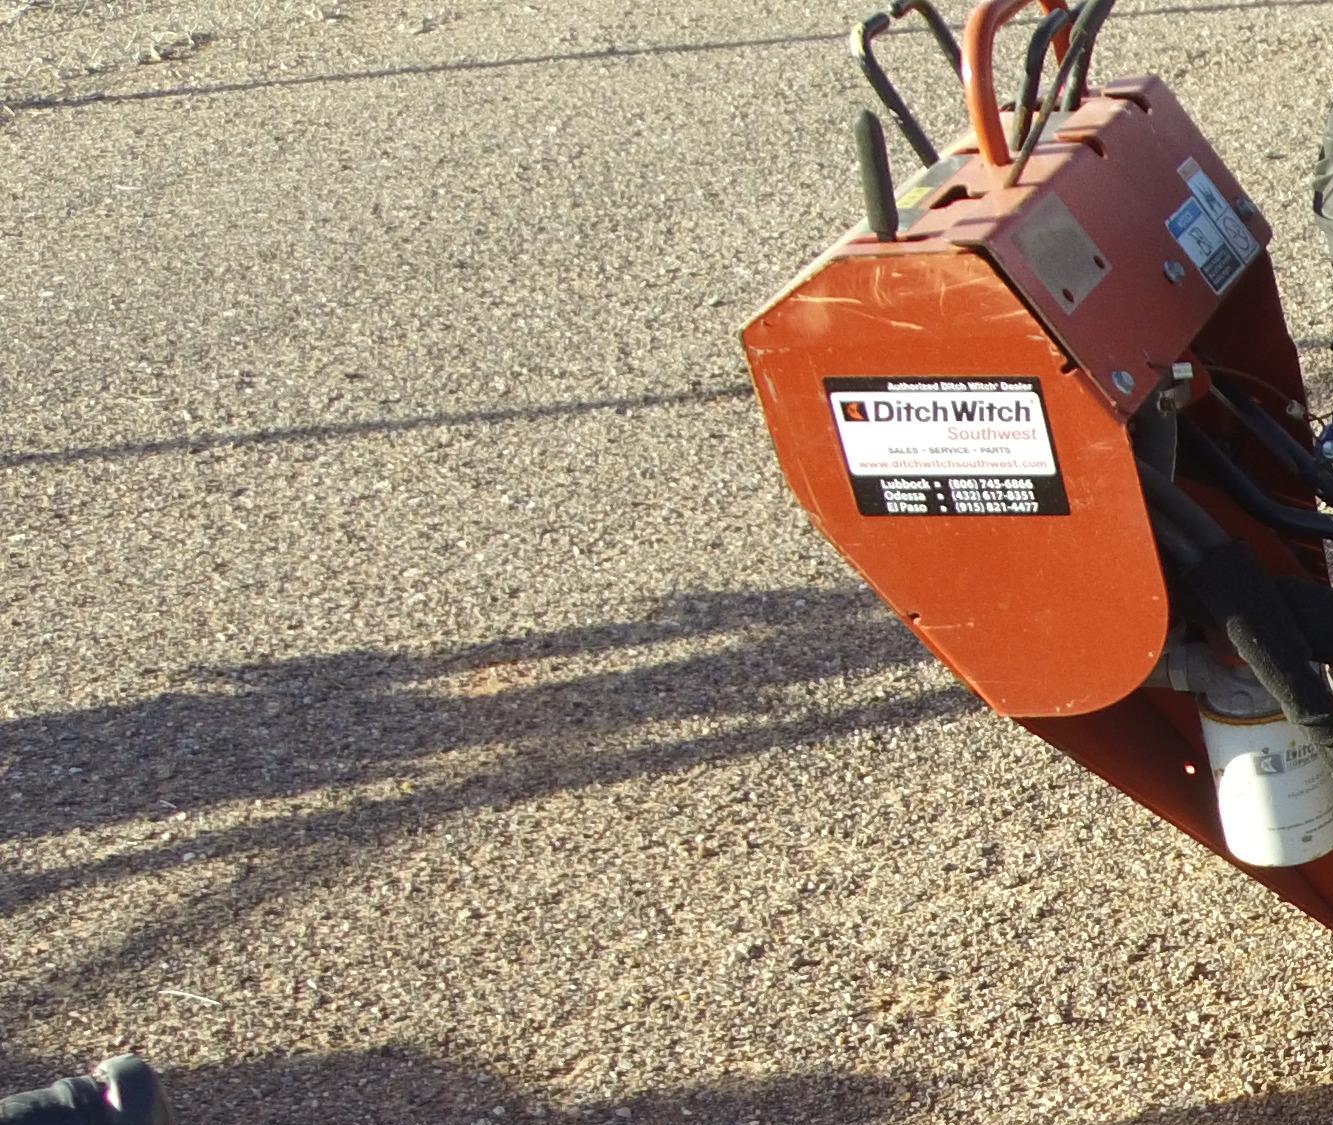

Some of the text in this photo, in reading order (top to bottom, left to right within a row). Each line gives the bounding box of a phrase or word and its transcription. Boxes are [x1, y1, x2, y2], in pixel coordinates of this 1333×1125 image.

[948, 427, 1037, 440] Southwest
[881, 479, 1033, 490] Lubbock (806) 745-6866
[884, 491, 1035, 501] Odessa (432) 617-8351
[900, 503, 928, 513] Paso
[955, 502, 985, 513] (915)
[987, 502, 1039, 513] 821-4477
